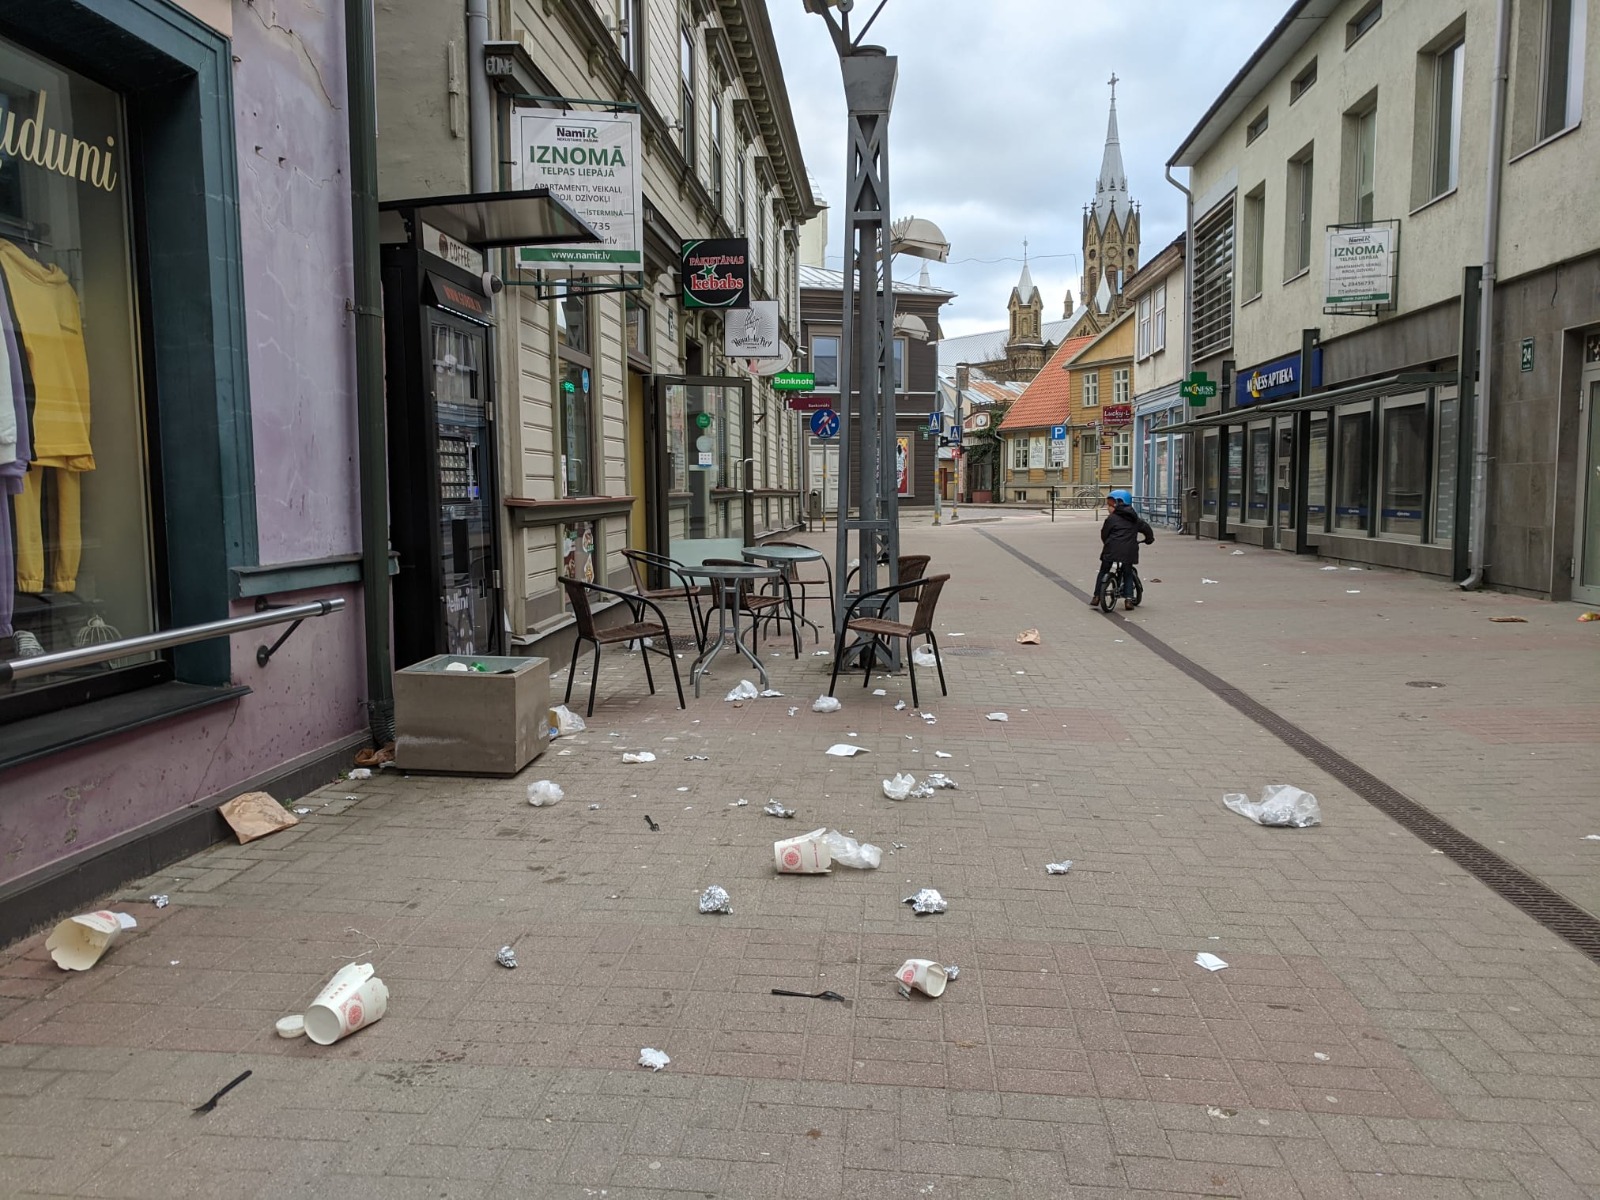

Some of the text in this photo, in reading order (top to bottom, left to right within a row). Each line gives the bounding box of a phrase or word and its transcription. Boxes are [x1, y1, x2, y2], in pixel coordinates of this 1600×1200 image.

[0, 89, 118, 192] udumi
[530, 146, 626, 167] IZNOMĀ
[541, 167, 615, 178] TELPAS LIEPĀJĀ
[450, 242, 470, 268] COFFEE
[551, 251, 610, 260] www.namir.lv
[1334, 243, 1384, 257] IZNOMĀ
[689, 255, 744, 266] PAKISTĀNAS
[691, 273, 744, 290] kebabs
[1523, 347, 1531, 362] 24
[774, 376, 814, 385] Banknote
[1268, 367, 1293, 388] APTIEKA
[1055, 427, 1064, 438] P
